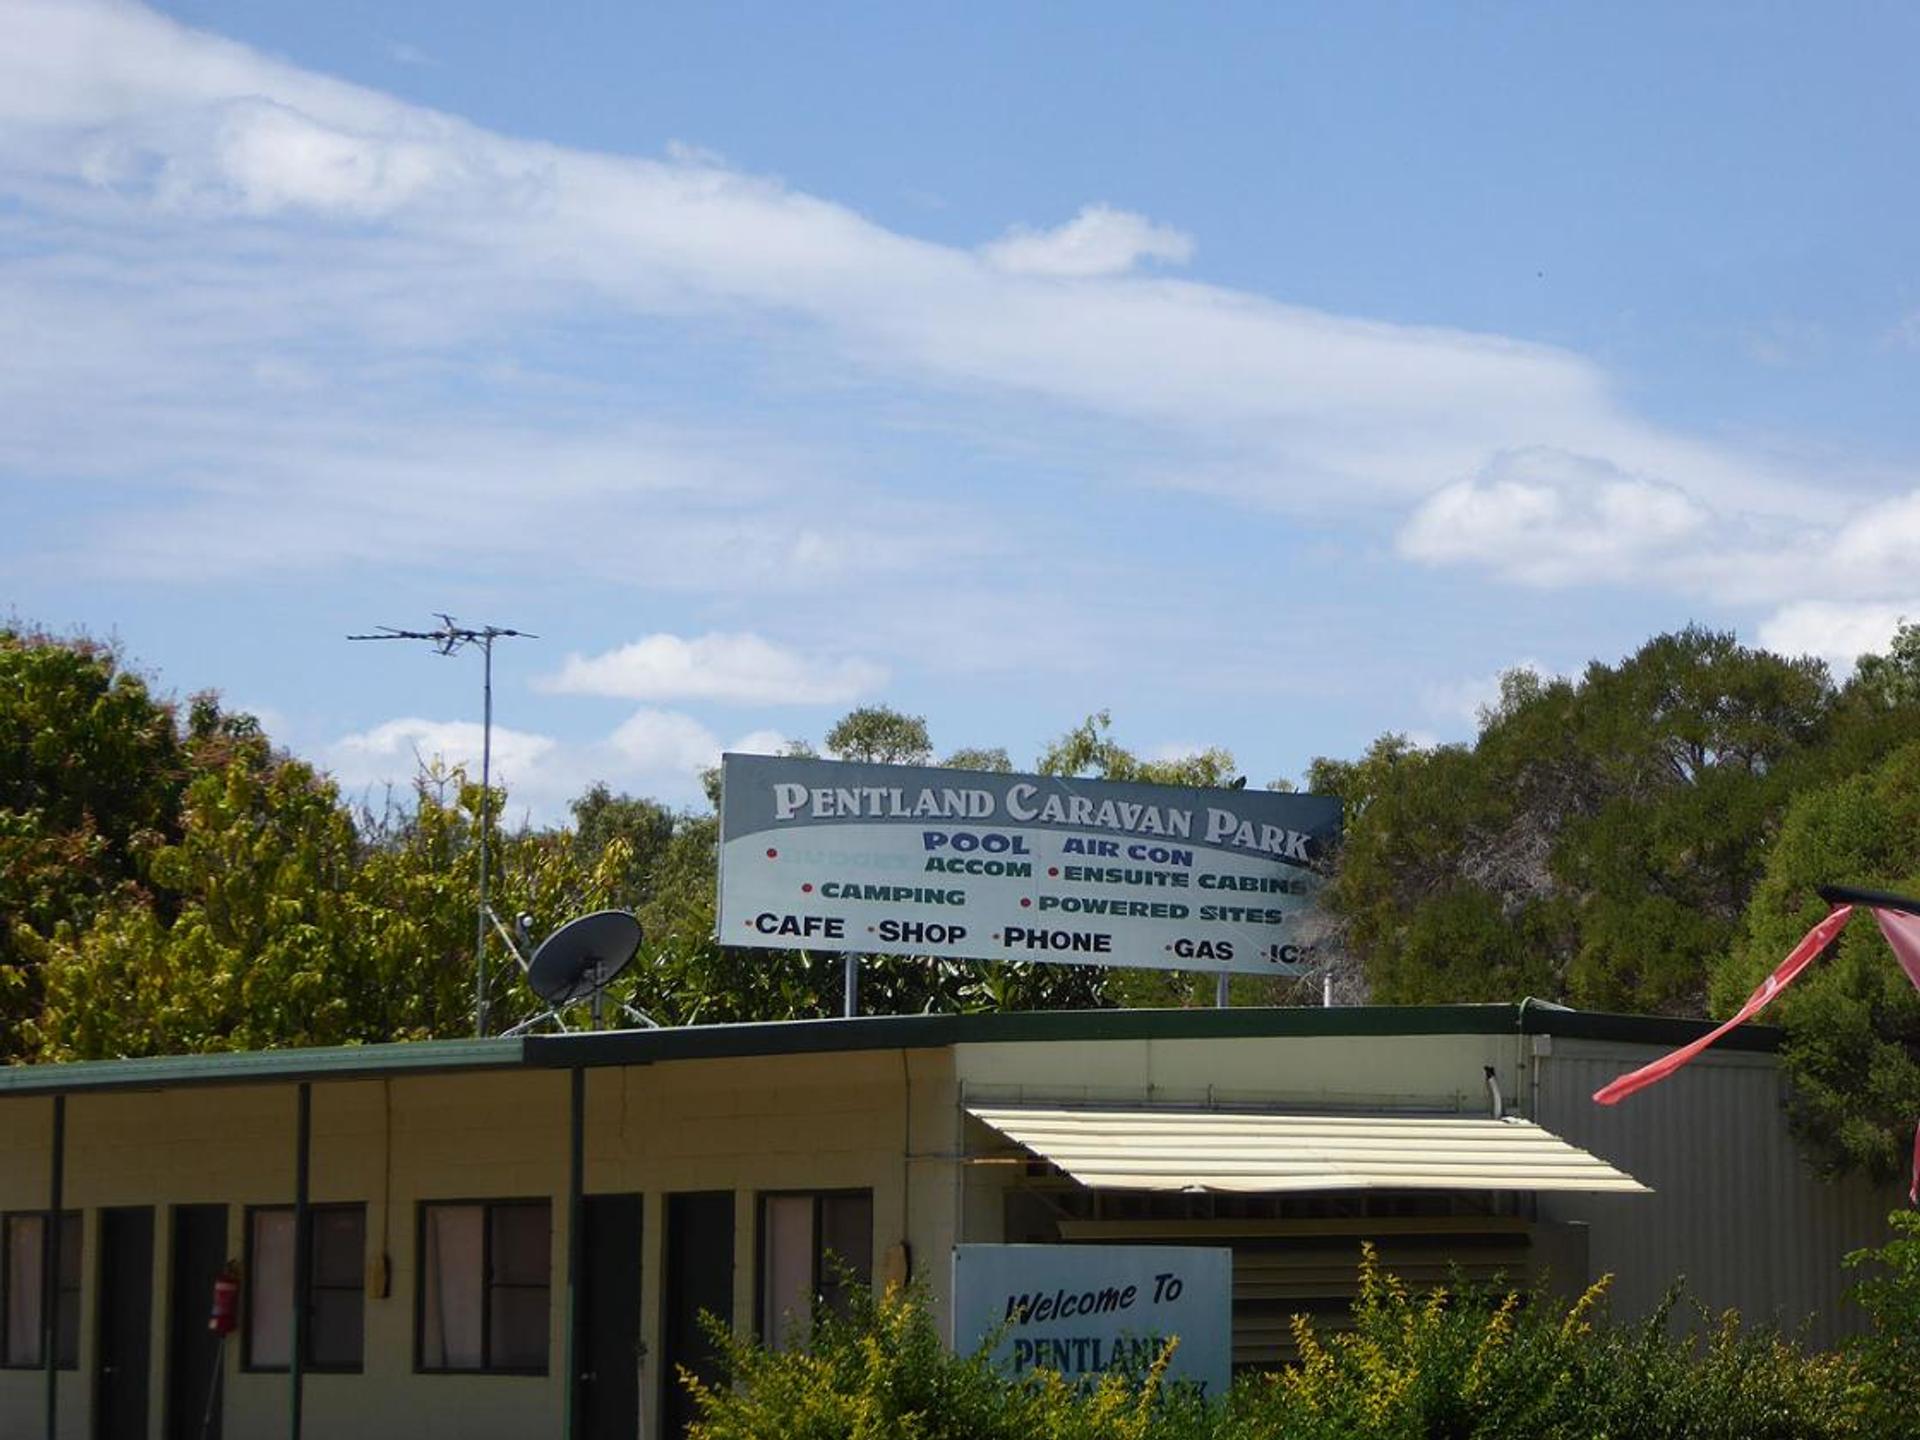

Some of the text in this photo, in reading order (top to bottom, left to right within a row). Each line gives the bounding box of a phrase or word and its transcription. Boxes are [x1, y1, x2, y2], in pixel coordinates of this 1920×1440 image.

[773, 783, 1313, 862] PENTLAND CARAVAN PARK
[922, 831, 1194, 867] POOL AIR CON
[925, 857, 1032, 878] ACCOM
[1064, 866, 1190, 888] ENSUITE
[1198, 873, 1307, 896] CABINS
[821, 882, 1283, 925] CAMPING POWERED SITES
[755, 913, 845, 939] CAFE
[879, 919, 967, 945] SHOP
[1003, 927, 1113, 953] PHONE
[1174, 938, 1234, 961] GAS
[1004, 1273, 1183, 1326] Welcome To
